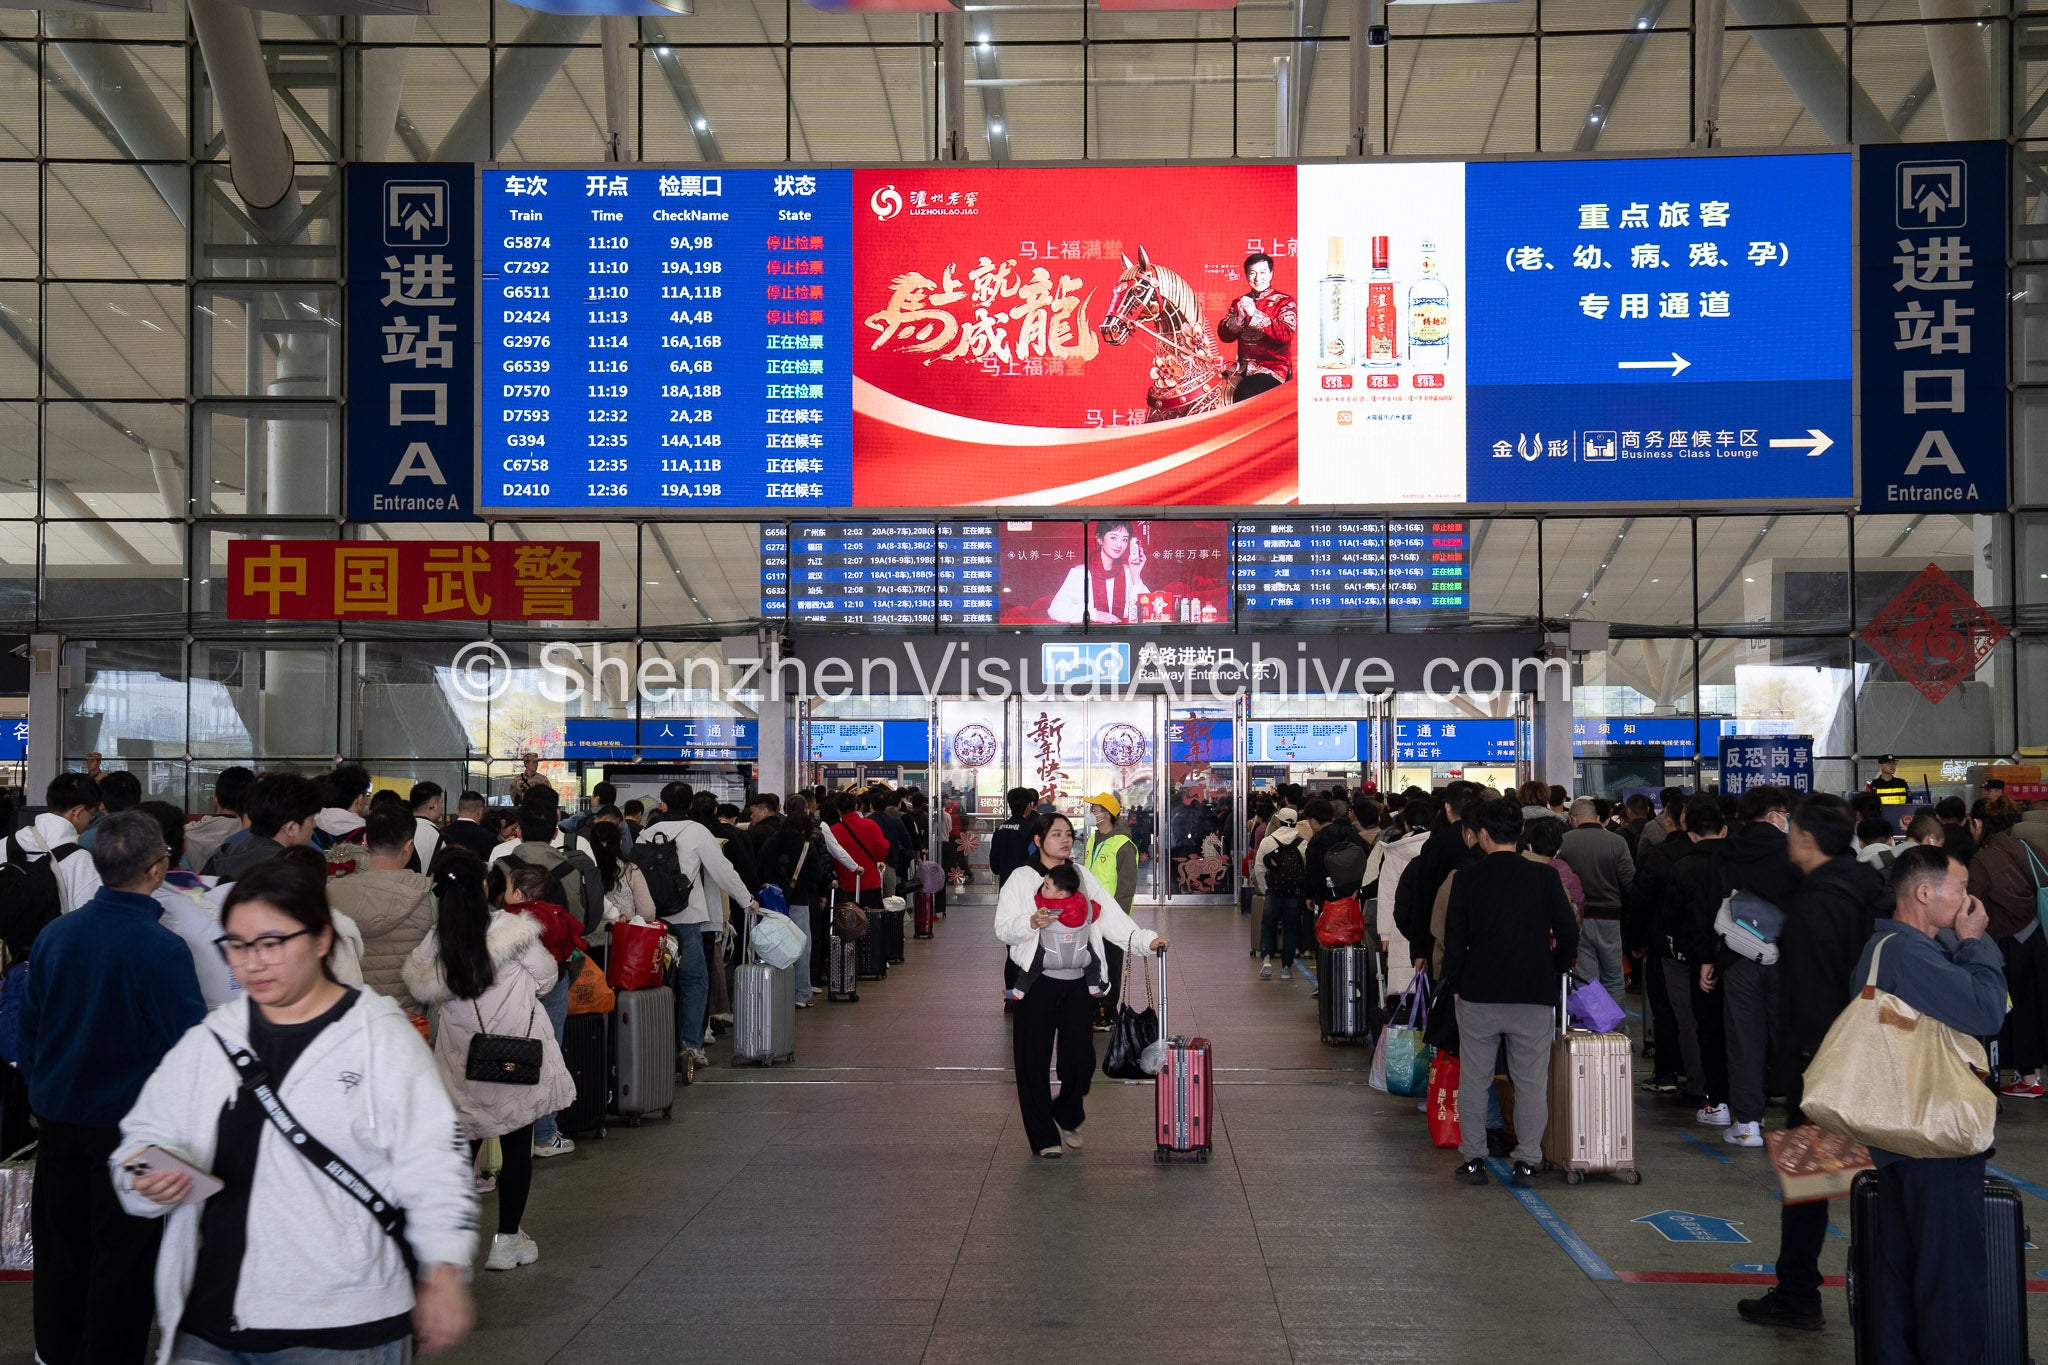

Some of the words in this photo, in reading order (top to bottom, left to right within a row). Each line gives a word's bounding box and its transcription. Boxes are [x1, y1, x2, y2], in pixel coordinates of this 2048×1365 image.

[505, 175, 547, 196] 车次
[586, 176, 628, 196] 开点
[659, 176, 721, 196] 检票口
[774, 175, 816, 196] 状态
[909, 190, 979, 208] 泸州老窖
[510, 210, 542, 220] Train
[592, 210, 623, 221] Time
[653, 210, 729, 221] CheckName
[779, 210, 811, 220] State
[909, 208, 979, 216] LUZHOULAOJIAO
[1577, 201, 1731, 230] 重点旅客
[504, 237, 550, 248] G5874
[589, 237, 628, 249] 11:10
[671, 237, 712, 250] 9A,9B
[767, 236, 823, 250] 停止检票
[504, 262, 549, 273] C7292
[589, 262, 628, 273] 11:10
[662, 262, 721, 275] 19A,19B
[767, 261, 823, 274] 停止检票
[504, 286, 550, 298] G6511
[589, 287, 628, 300] 11:10
[662, 286, 721, 300] 11A,11B
[767, 285, 823, 300] 停止检票
[1578, 292, 1731, 320] 专用通道
[504, 311, 550, 323] D2424
[589, 311, 628, 323] 11:13
[670, 311, 712, 324] 4A,4B
[767, 310, 823, 324] 停止检票
[503, 336, 550, 347] G2976
[589, 336, 628, 347] 11:14
[662, 336, 721, 349] 16A,16B
[767, 335, 823, 349] 正在检票
[503, 361, 550, 372] G6539
[589, 361, 628, 372] 11:16
[670, 361, 712, 374] 6A,6B
[767, 359, 823, 374] 正在检票
[504, 385, 550, 397] D7570
[589, 386, 627, 397] 11:19
[662, 385, 721, 398] 18A,18B
[766, 384, 823, 399] 正在检票
[504, 410, 549, 421] D7593
[589, 410, 627, 422] 12:32
[670, 410, 712, 423] 2A,2B
[766, 409, 823, 423] 正在候车
[507, 435, 545, 446] G394
[589, 435, 627, 446] 12:35
[662, 435, 721, 448] 14A,14B
[766, 434, 823, 448] 正在候车
[1621, 429, 1759, 449] 商务座候车区
[1621, 449, 1675, 460] Business
[1679, 449, 1712, 460] Class
[1716, 448, 1759, 461] Lounge
[504, 459, 548, 471] C6758
[589, 460, 627, 471] 12:35
[662, 459, 721, 473] 11A,11B
[766, 458, 823, 473] 正在候车
[503, 484, 549, 496] D2410
[588, 484, 627, 496] 12:36
[662, 484, 721, 497] 19A,19B
[766, 483, 823, 497] 正在候车
[1887, 485, 1963, 502] Entrance
[1965, 484, 1979, 500] A
[373, 494, 444, 511] Entrance
[447, 494, 459, 511] A
[843, 528, 863, 536] 12:02
[962, 527, 992, 535] 正在候车
[1432, 524, 1462, 532] 停止检票
[962, 542, 992, 550] 正在候车
[1432, 538, 1462, 546] 停止检票
[808, 558, 822, 566] 九江
[962, 556, 992, 564] 正在候车
[1017, 550, 1076, 561] 认养一头牛
[1163, 549, 1222, 560] 新年万事牛
[1432, 553, 1462, 561] 停止检票
[962, 571, 992, 579] 正在候车
[1432, 568, 1462, 576] 正在检票
[243, 544, 583, 616] 中国武警
[1432, 582, 1462, 591] 正在检票
[962, 585, 992, 593] 正在候车
[962, 600, 992, 608] 正在候车
[1270, 598, 1293, 606] 广州东
[1432, 597, 1462, 605] 正在检票
[962, 614, 992, 622] 正在候车
[1138, 646, 1234, 666] 铁路进站口
[1138, 669, 1184, 682] Railway
[1188, 669, 1241, 680] Entrance
[660, 724, 746, 738] 人工通道
[681, 749, 731, 758] 所有证件
[1726, 746, 1808, 768] 反恐岗亭
[1726, 772, 1808, 794] 谢绝询问
